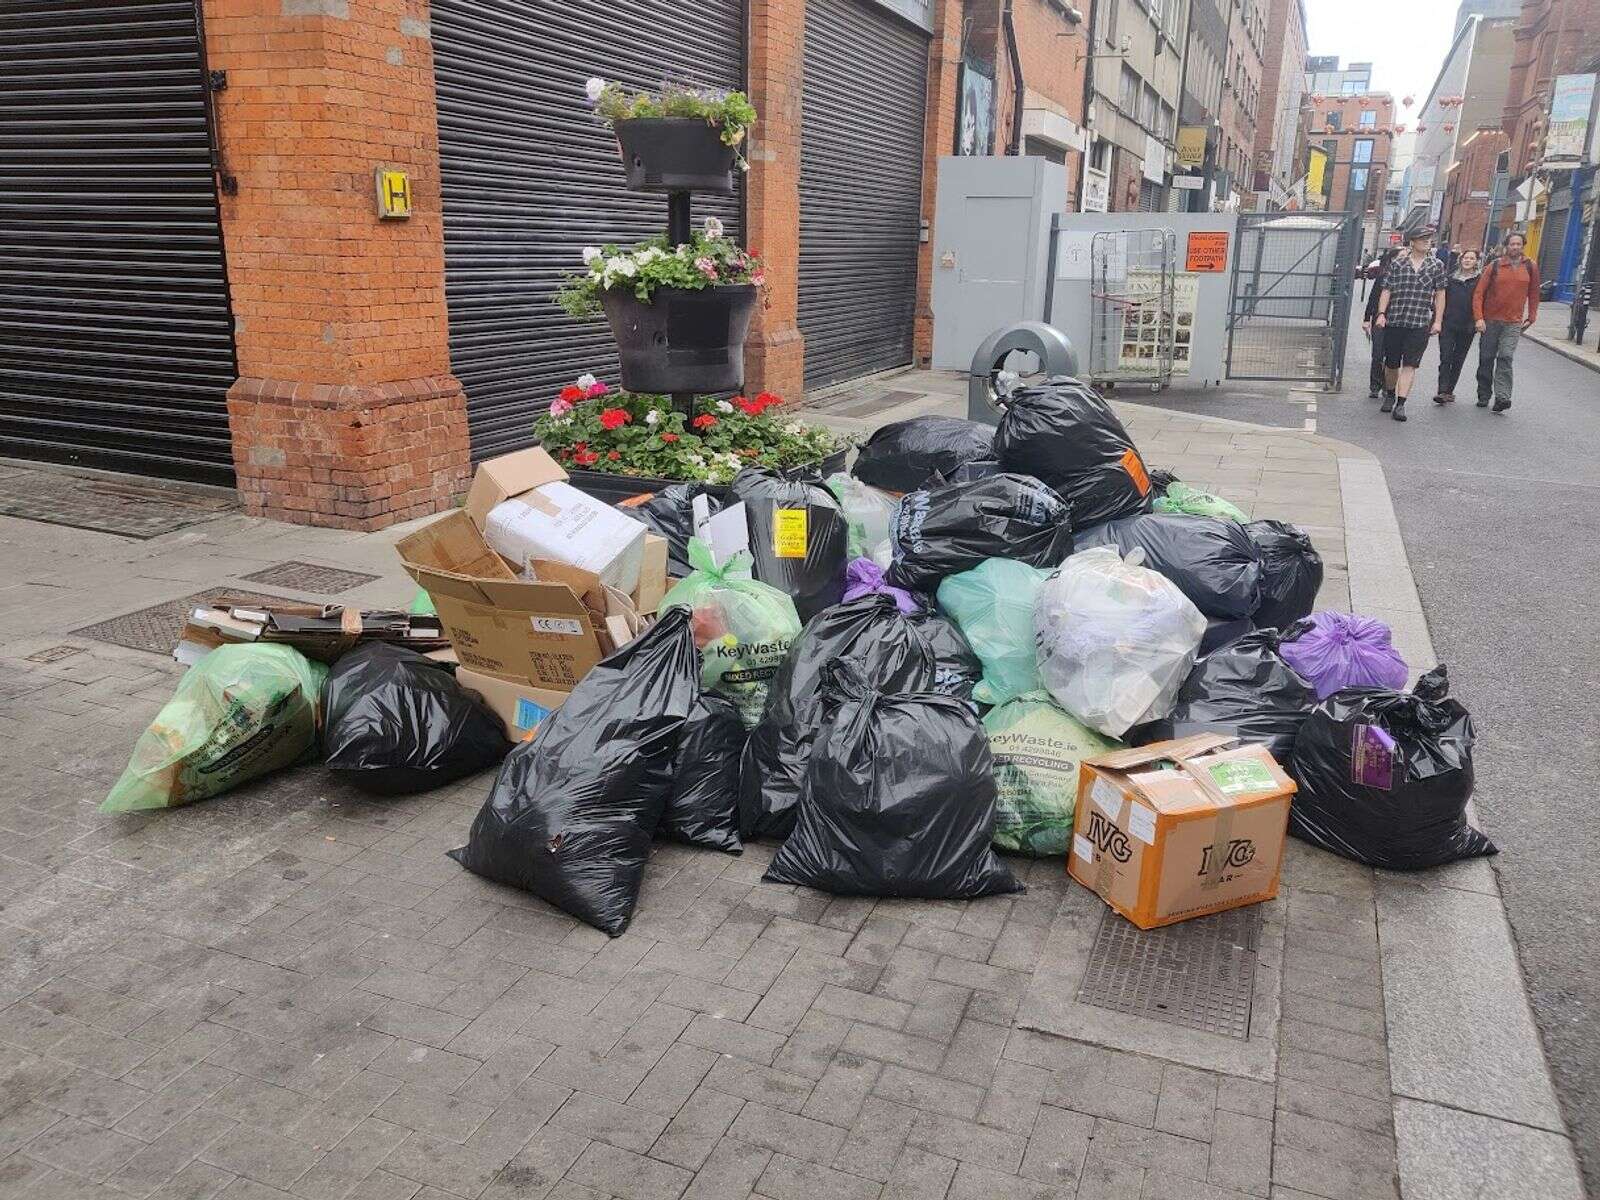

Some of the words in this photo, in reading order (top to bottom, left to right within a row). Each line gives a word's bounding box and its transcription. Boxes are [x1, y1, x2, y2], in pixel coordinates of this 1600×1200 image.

[388, 177, 408, 211] H
[1203, 247, 1225, 255] OTHER
[1189, 255, 1224, 263] FOOTPATH
[1013, 755, 1069, 770] RECYCLING
